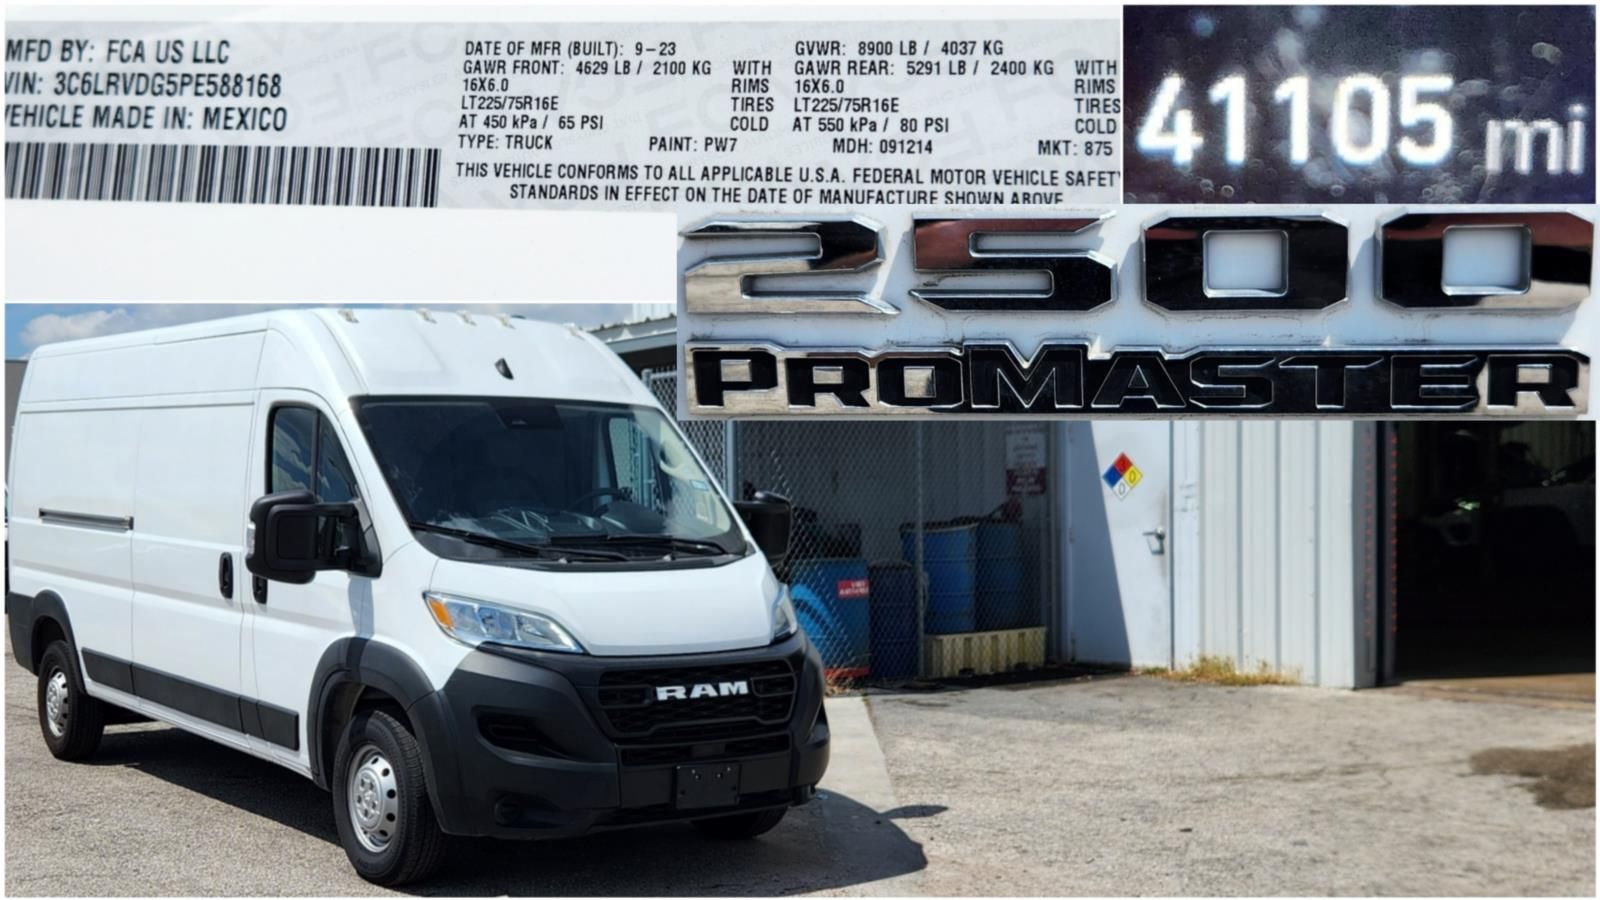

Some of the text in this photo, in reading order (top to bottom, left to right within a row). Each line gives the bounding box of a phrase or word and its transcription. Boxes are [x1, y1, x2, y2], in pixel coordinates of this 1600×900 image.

[5, 38, 230, 64] MFD BY: FCA US LLC
[465, 41, 501, 56] DATE
[507, 41, 525, 56] OF
[531, 41, 561, 56] MFR
[568, 41, 624, 59] (BUILT):
[795, 40, 845, 56] GVWR:
[858, 41, 893, 56] 8900
[900, 40, 917, 56] LB
[941, 41, 977, 56] 4037
[983, 40, 1003, 55] KG
[463, 60, 506, 75] GAWR
[513, 60, 564, 75] FRONT:
[576, 61, 608, 75] 4629
[614, 60, 631, 75] LB
[653, 61, 686, 75] 2100
[692, 60, 711, 75] KG
[733, 60, 772, 75] WITH
[794, 60, 841, 76] GAWR
[847, 60, 894, 75] REAR:
[907, 60, 940, 75] 5291
[949, 60, 966, 75] LB
[991, 60, 1026, 75] 2400
[1033, 60, 1054, 75] KG
[1075, 60, 1116, 75] WITH
[53, 71, 281, 98] 3C6LRVDG5PE588168
[463, 77, 769, 94] 16X6.0 RIMS
[795, 78, 1115, 94] 16X6.0 RIMS
[461, 95, 774, 112] LT225/75R16E TIRES
[794, 97, 1120, 114] LT225/75R16E TIRES
[92, 105, 155, 129] MADE
[163, 106, 193, 129] IN:
[202, 106, 287, 132] MEXICO
[459, 114, 478, 128] AT
[483, 114, 507, 129] 450
[512, 114, 537, 129] kPa
[558, 115, 575, 130] 65
[581, 115, 603, 130] PSI
[730, 116, 769, 132] COLD
[792, 116, 812, 132] AT
[818, 117, 844, 132] 550
[850, 117, 877, 132] kPa
[900, 118, 918, 133] 80
[924, 117, 949, 133] PSI
[1075, 118, 1117, 134] COLD
[1137, 72, 1586, 175] 41105 mi
[458, 134, 553, 150] TYPE: TRUCK
[649, 136, 738, 152] PAINT: PW7
[833, 137, 933, 154] MDH: 091214
[1038, 140, 1113, 156] MKT: 875
[456, 162, 1120, 187] THIS VEHICLE CONFORMS TO ALL APPLICABLE U.S.A. FEDERAL MOTOR VEHICLE SAFET
[510, 184, 599, 200] STANDARDS
[605, 185, 619, 201] IN
[625, 185, 680, 202] EFFECT
[685, 186, 706, 202] ON
[712, 187, 741, 203] THE
[748, 187, 787, 204] DATE
[793, 188, 813, 204] OF
[819, 189, 938, 204] MANUFACTURE
[944, 190, 1004, 204] SHOWN
[680, 212, 1596, 315] 2500
[656, 681, 749, 701] RAM
